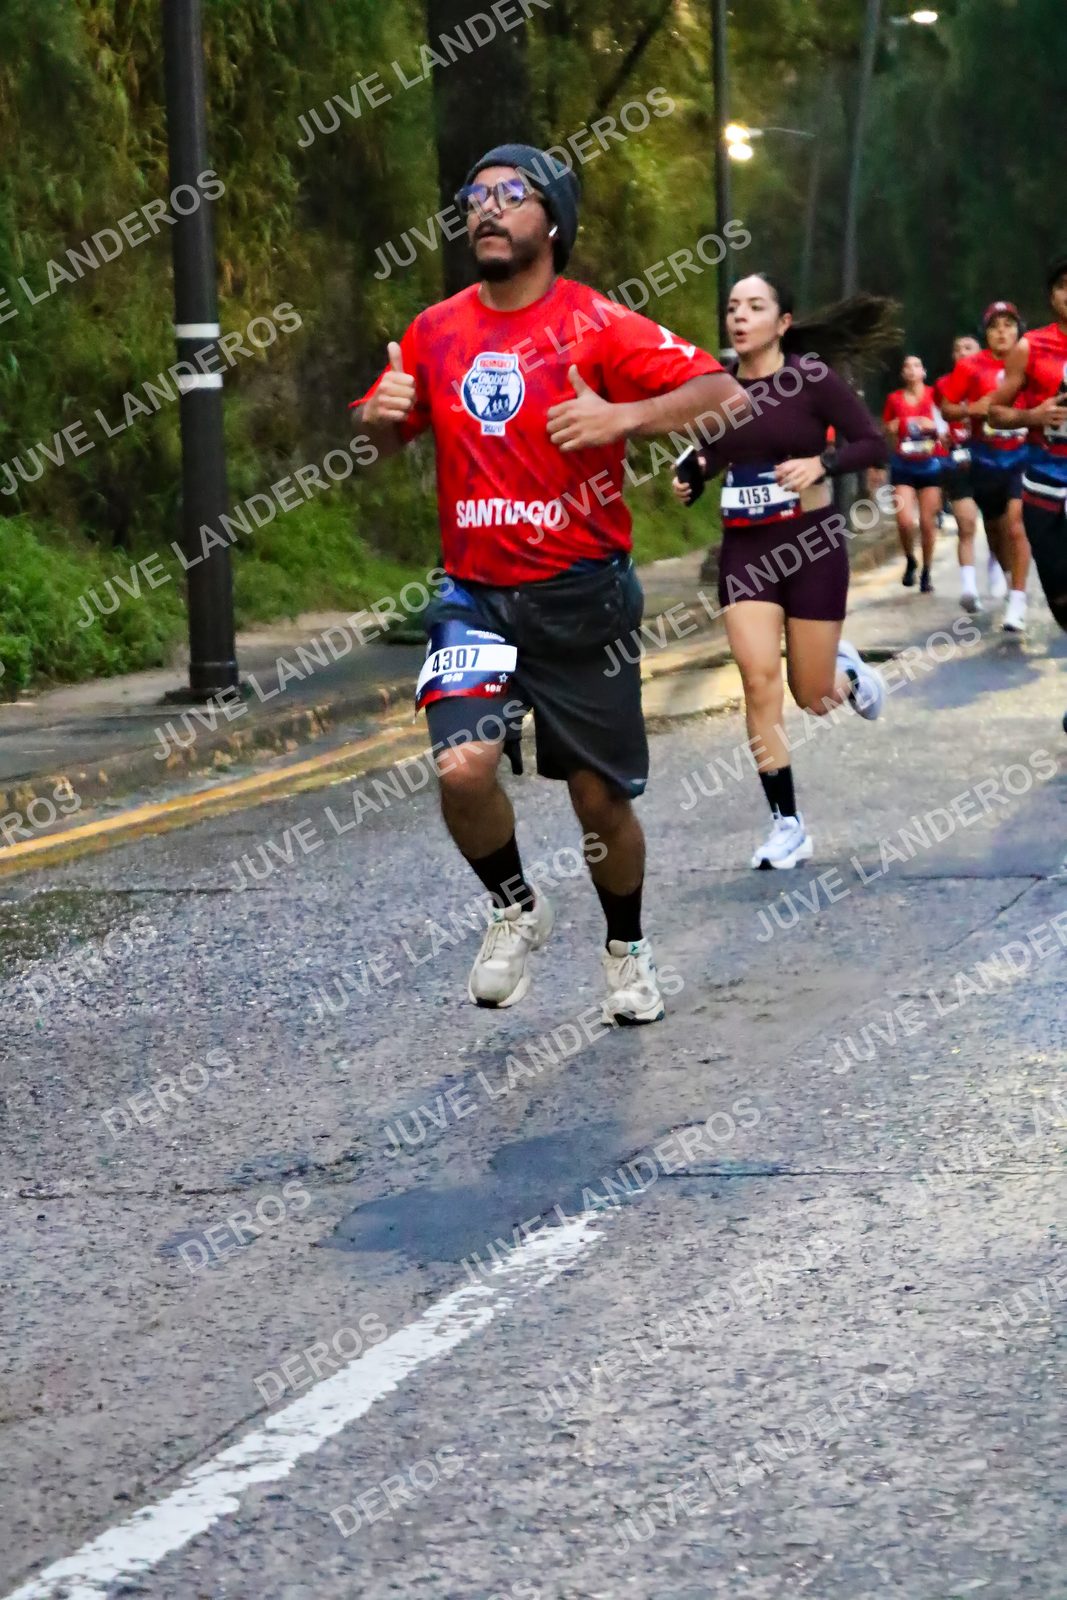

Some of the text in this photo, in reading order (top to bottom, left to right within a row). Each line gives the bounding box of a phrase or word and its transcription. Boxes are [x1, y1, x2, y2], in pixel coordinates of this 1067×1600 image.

[738, 487, 771, 505] 4153
[456, 498, 561, 528] SANTIAGO
[432, 647, 480, 673] 4307
